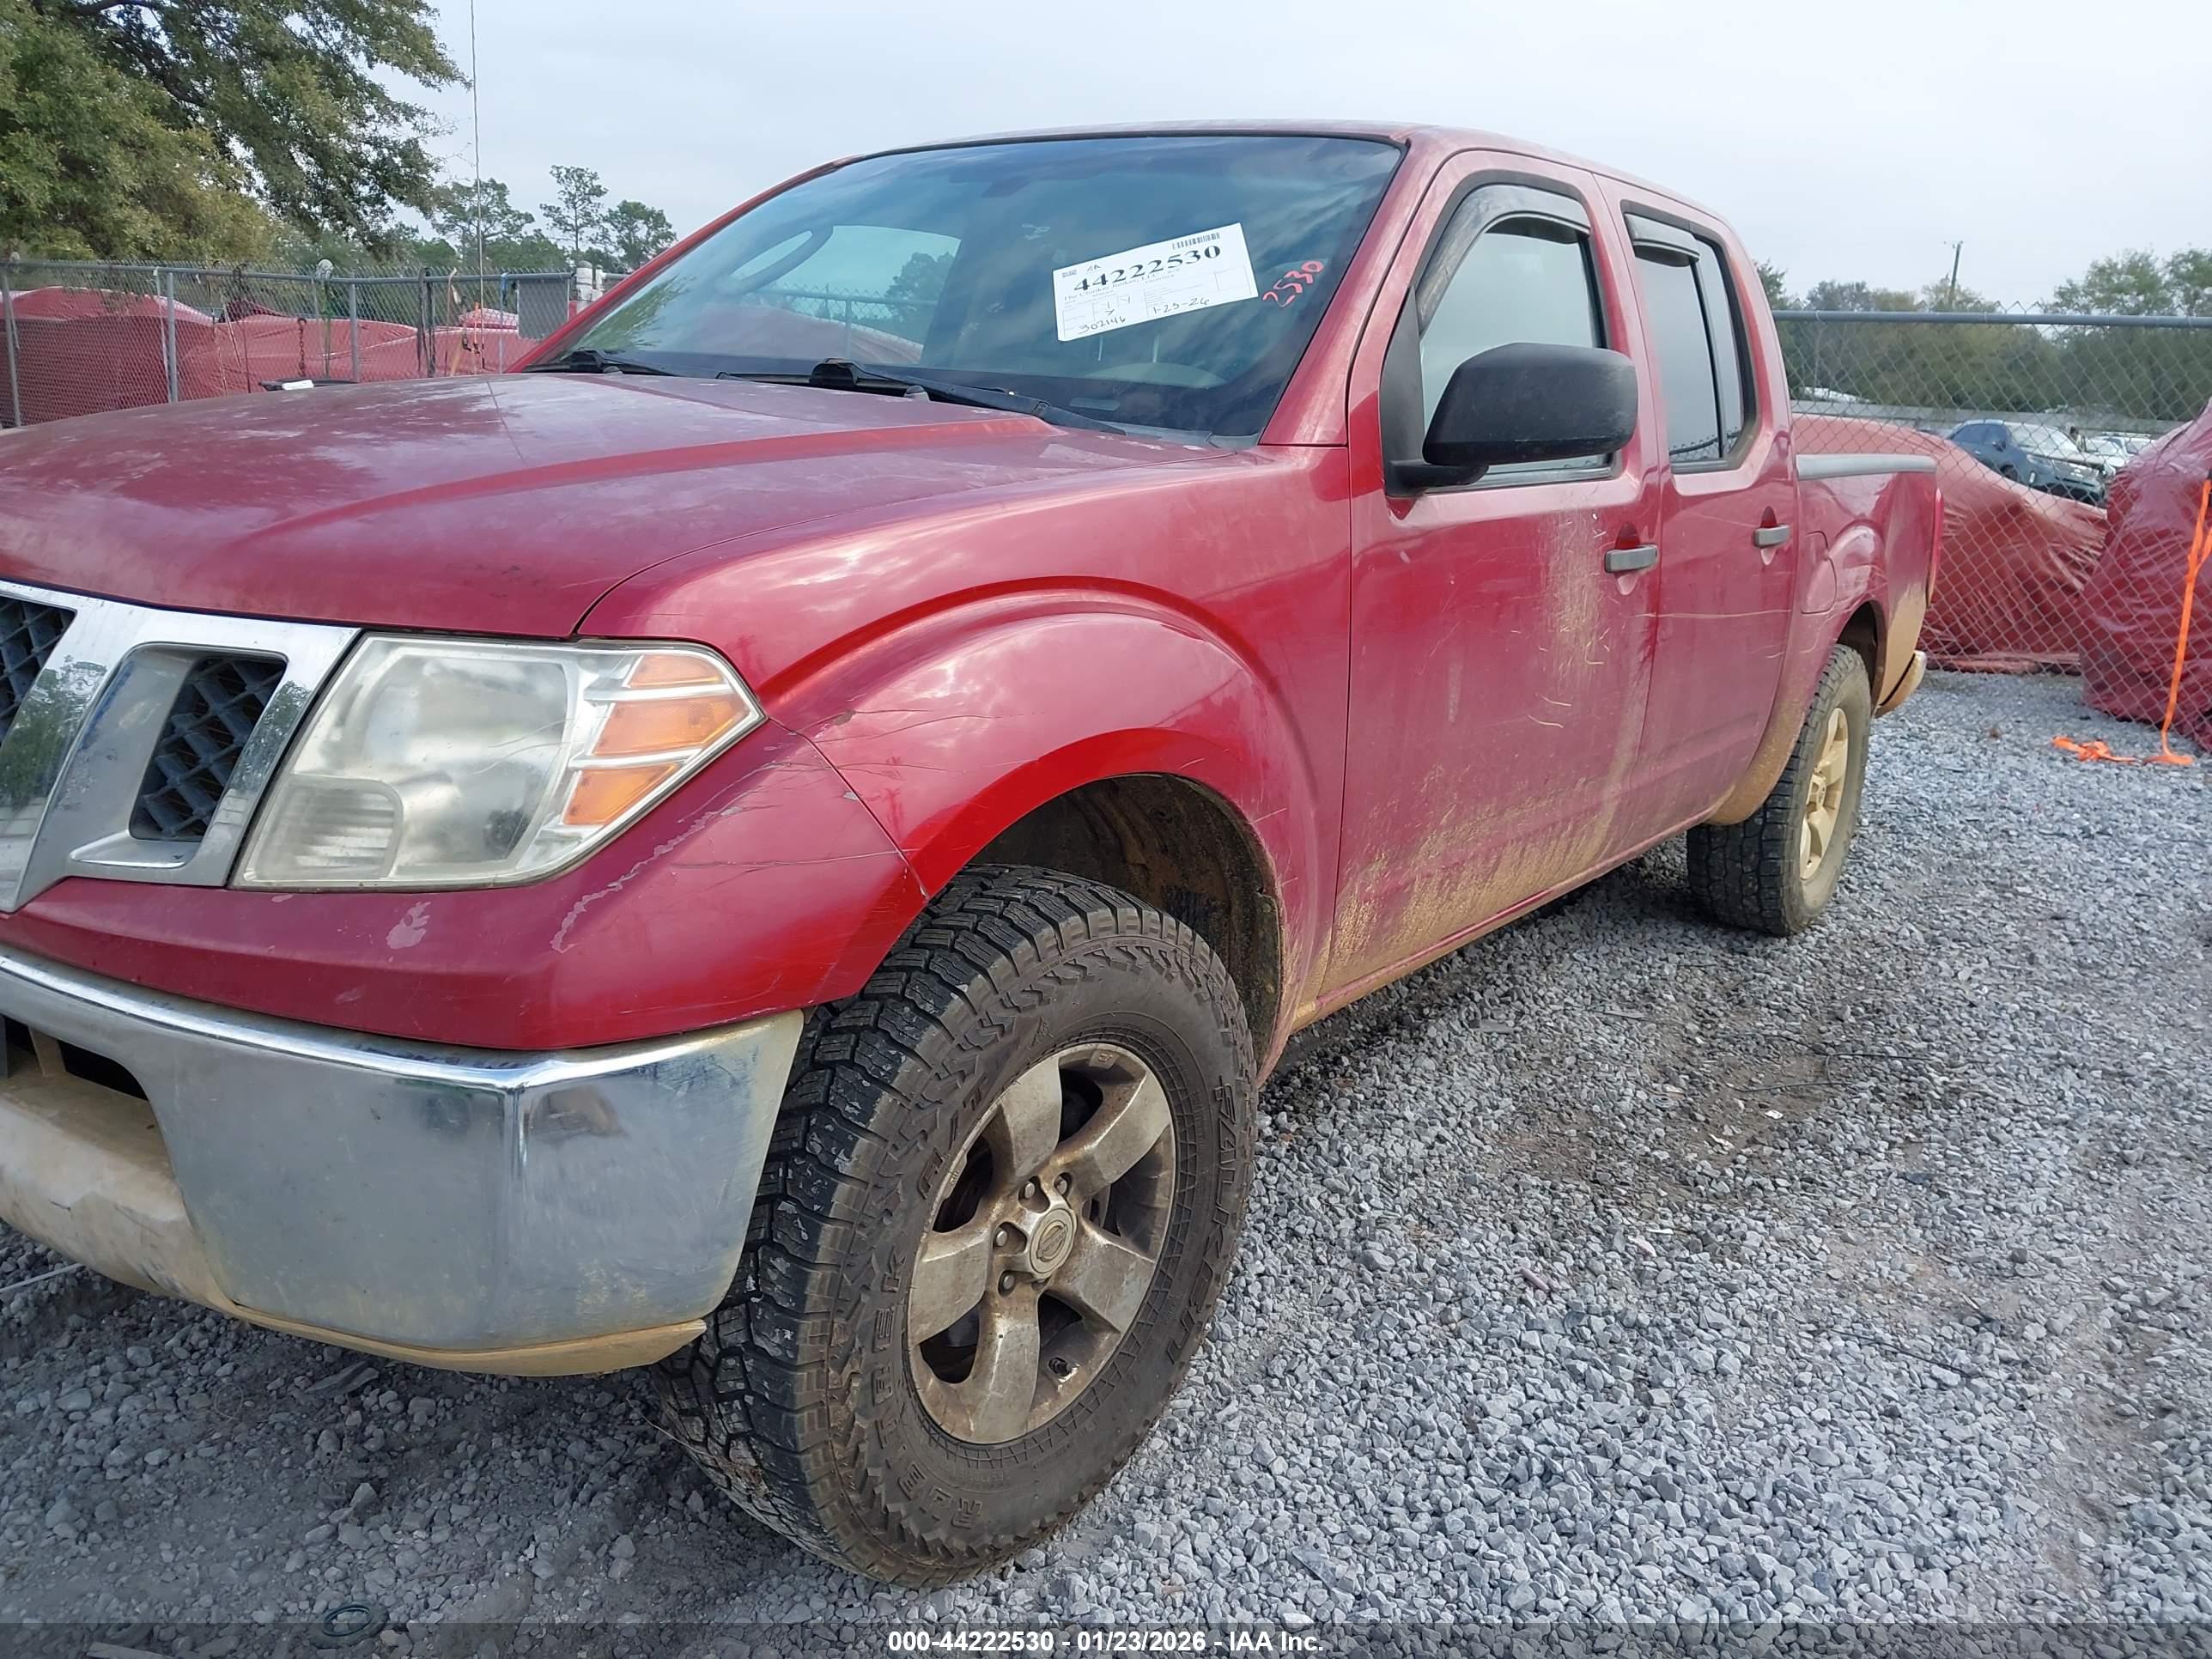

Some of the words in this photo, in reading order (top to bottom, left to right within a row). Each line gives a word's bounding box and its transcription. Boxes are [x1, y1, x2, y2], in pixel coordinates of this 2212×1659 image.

[1073, 246, 1221, 291] 44222530
[1262, 260, 1325, 307] 2530
[918, 1073, 988, 1200] A/T
